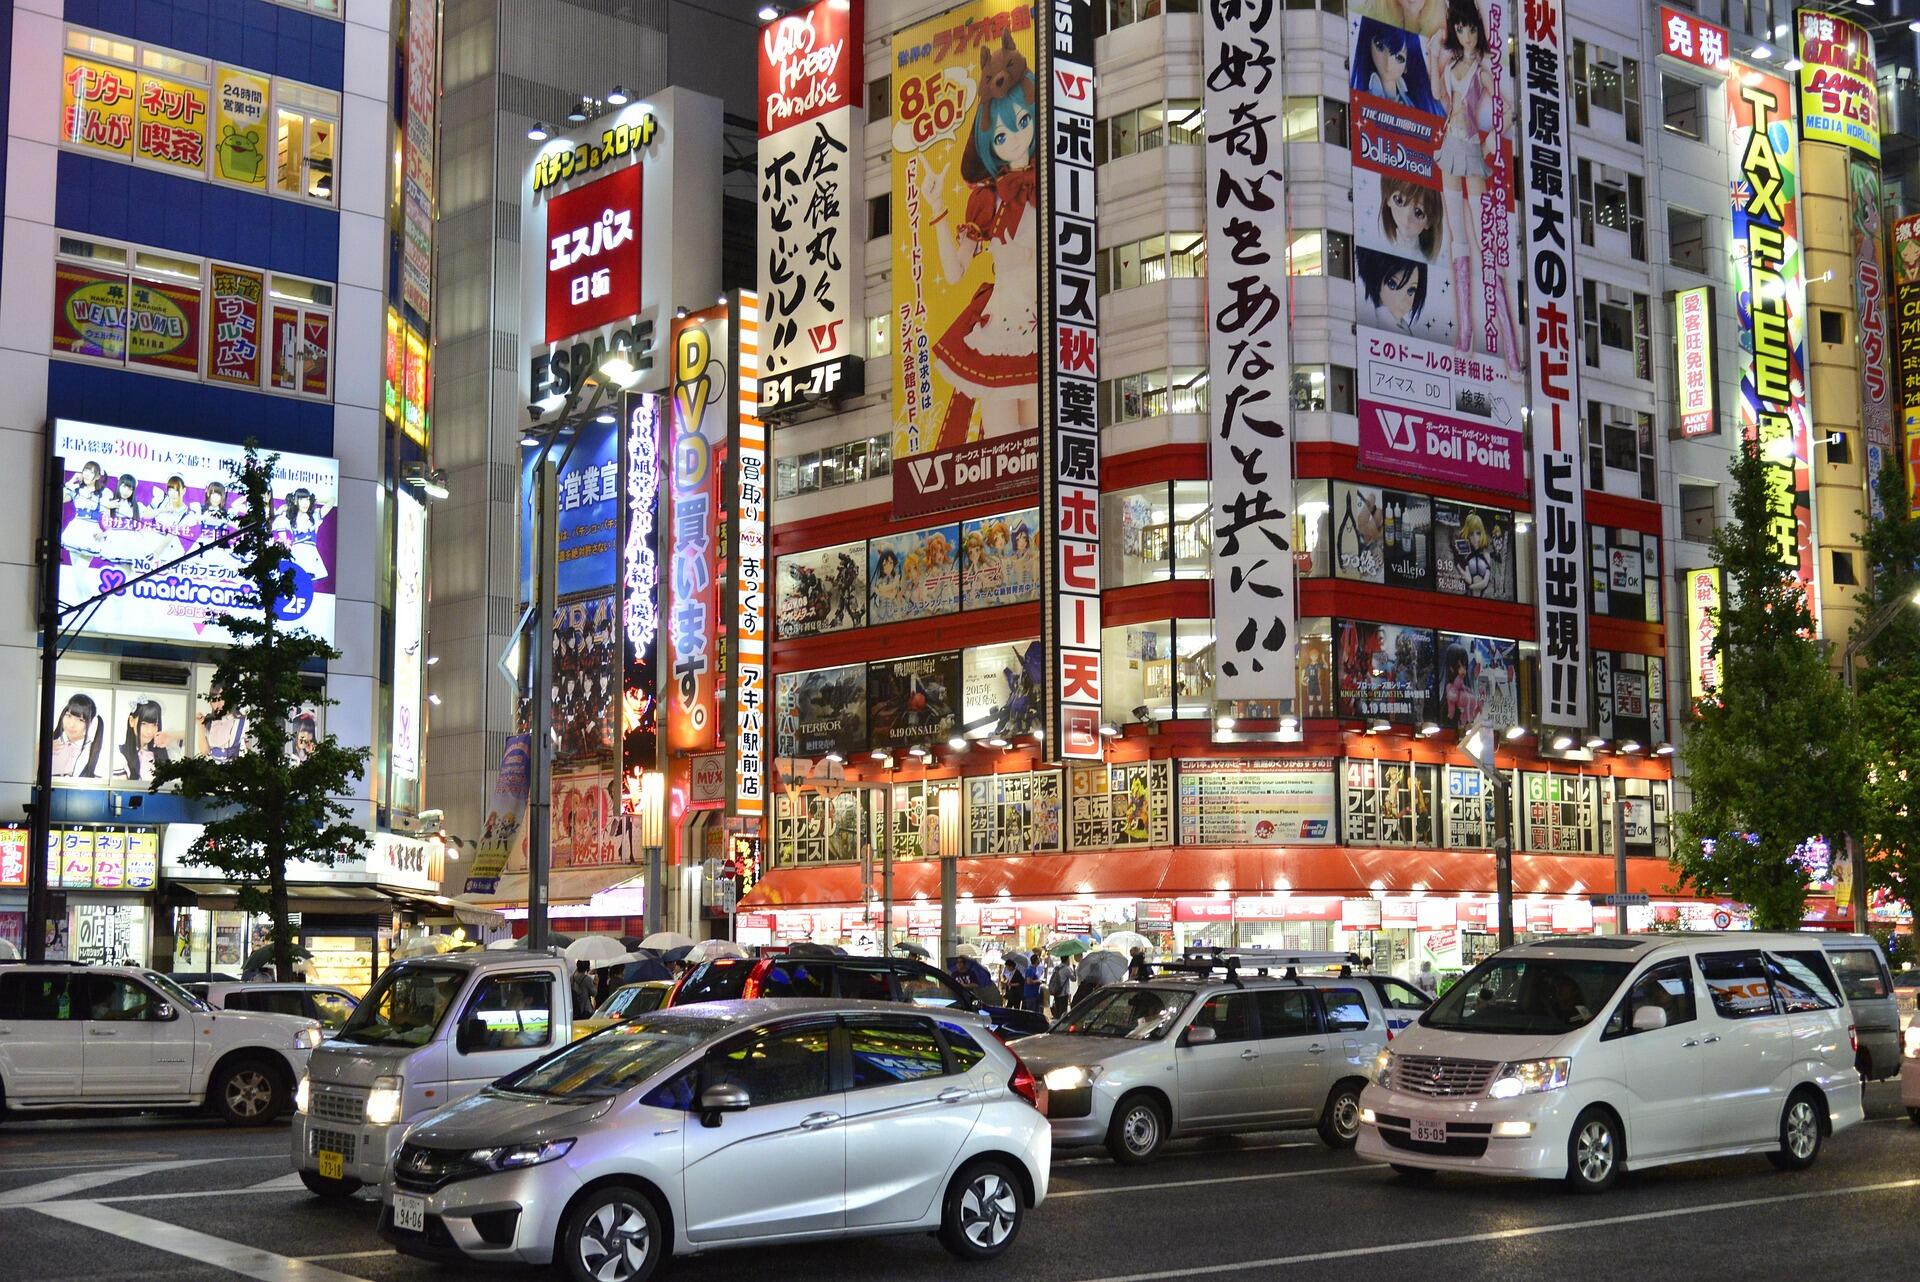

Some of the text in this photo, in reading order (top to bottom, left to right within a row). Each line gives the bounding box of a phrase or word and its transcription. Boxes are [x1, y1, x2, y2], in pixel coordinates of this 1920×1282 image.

[1667, 15, 1724, 67] 免税
[65, 65, 205, 122] インター ネット
[222, 83, 263, 106] 24時間
[912, 90, 965, 144] GO!
[1805, 115, 1871, 145] MEDIA WORLD
[63, 106, 203, 166] まんが 喫茶
[1741, 86, 1785, 226] TAX
[802, 121, 849, 312] 全館丸々
[549, 208, 633, 272] エスパス
[72, 300, 183, 338] WELCOME
[1748, 226, 1792, 405] FREE
[1859, 261, 1886, 403] ラムタラ
[529, 319, 654, 403] ESPACE
[1523, 0, 1580, 716] 秋葉原最大のホビービル出現!!
[1683, 293, 1705, 409] 愛客旺免税店
[216, 368, 250, 381] AKIBA
[1375, 372, 1441, 399] アイマス DD
[1460, 388, 1487, 410] 検索
[1685, 421, 1708, 434] ONE
[1426, 431, 1511, 471] Doll Point
[954, 458, 992, 486] Doll
[741, 456, 763, 521] 買取り
[672, 326, 713, 731] DVD買います。
[1391, 560, 1426, 579] vallejo
[1436, 559, 1454, 572] 9.19
[1628, 577, 1639, 587] OK
[1696, 574, 1712, 601] 免税
[1698, 605, 1714, 642] TAX
[966, 683, 992, 696] 2015年
[741, 668, 762, 796] アキバ駅前店
[800, 720, 842, 735] TERROR
[906, 725, 919, 737] ON
[1073, 771, 1108, 796] 3F
[1450, 771, 1480, 796] 5F
[1530, 776, 1560, 801] 6F
[1073, 797, 1109, 820] 食玩
[1074, 817, 1146, 835] トレーディング
[1636, 825, 1649, 837] OK
[1417, 1127, 1445, 1141] 85-09
[400, 1209, 422, 1228] 94-06
